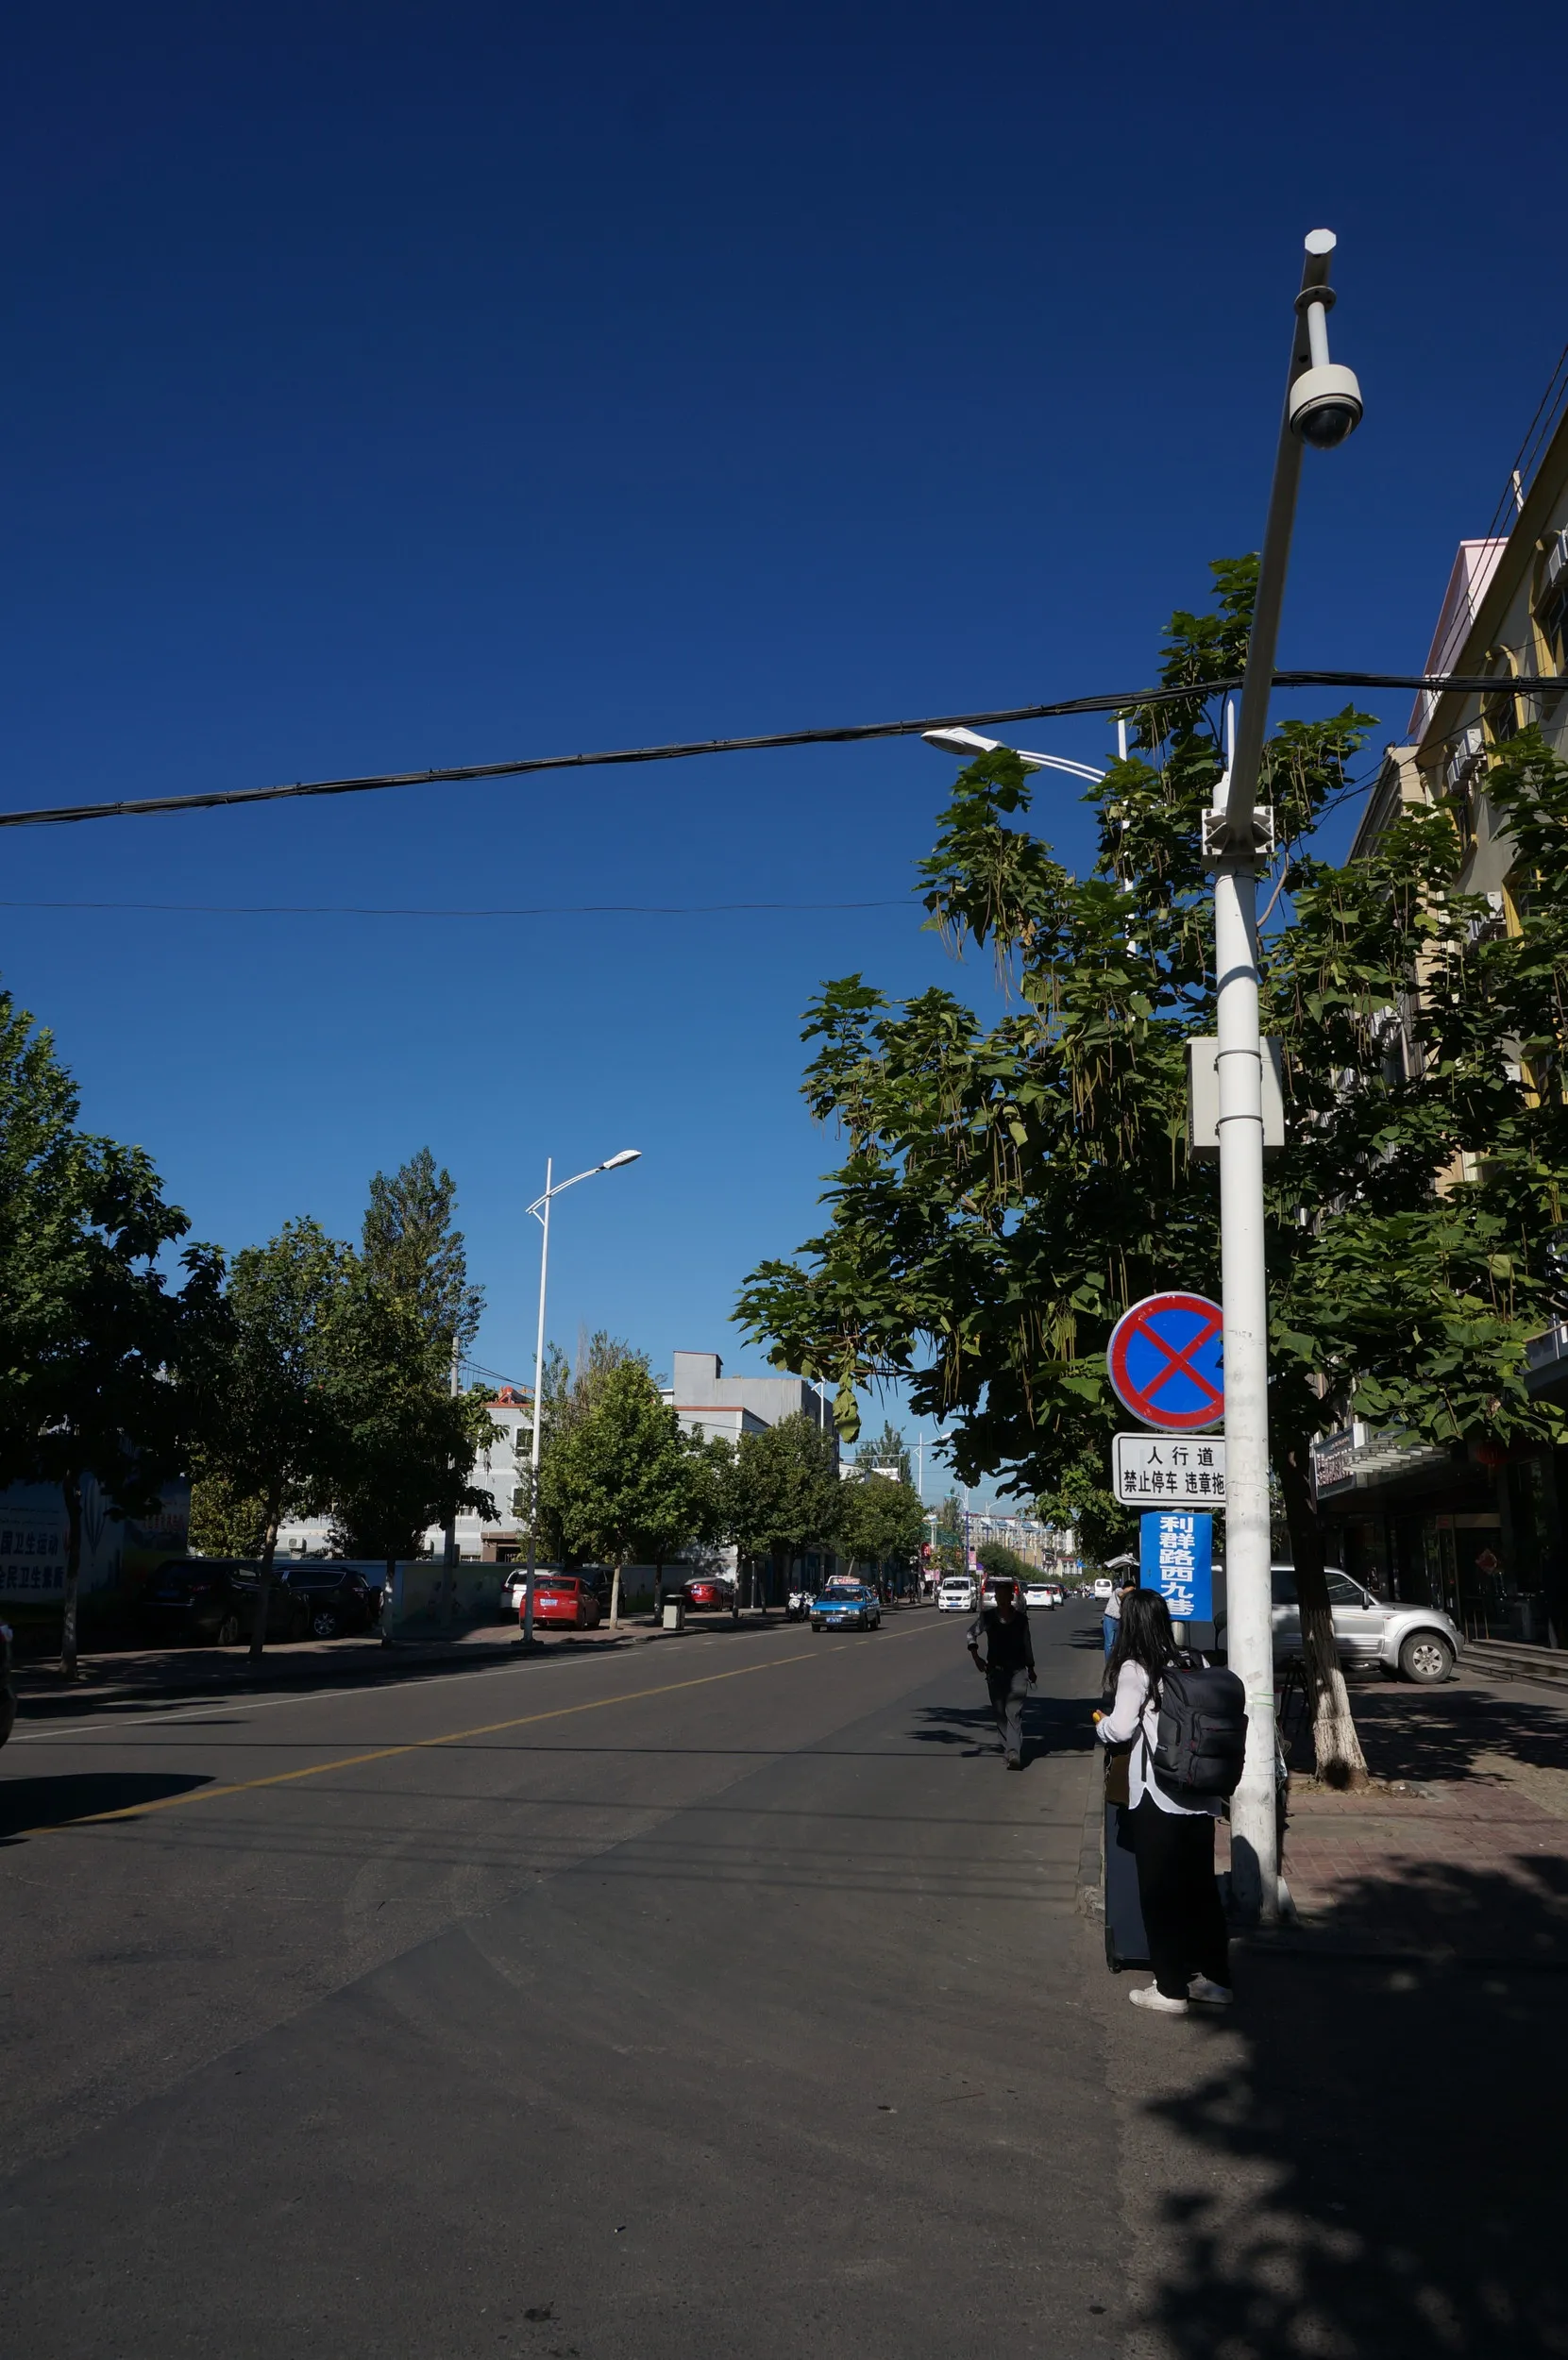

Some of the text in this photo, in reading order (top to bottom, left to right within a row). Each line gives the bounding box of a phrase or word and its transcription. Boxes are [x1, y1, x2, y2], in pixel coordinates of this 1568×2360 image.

[1147, 1446, 1214, 1466] 人行道
[1124, 1470, 1225, 1495] 禁止停车 违章拖
[1159, 1516, 1196, 1616] 利群路西九巷
